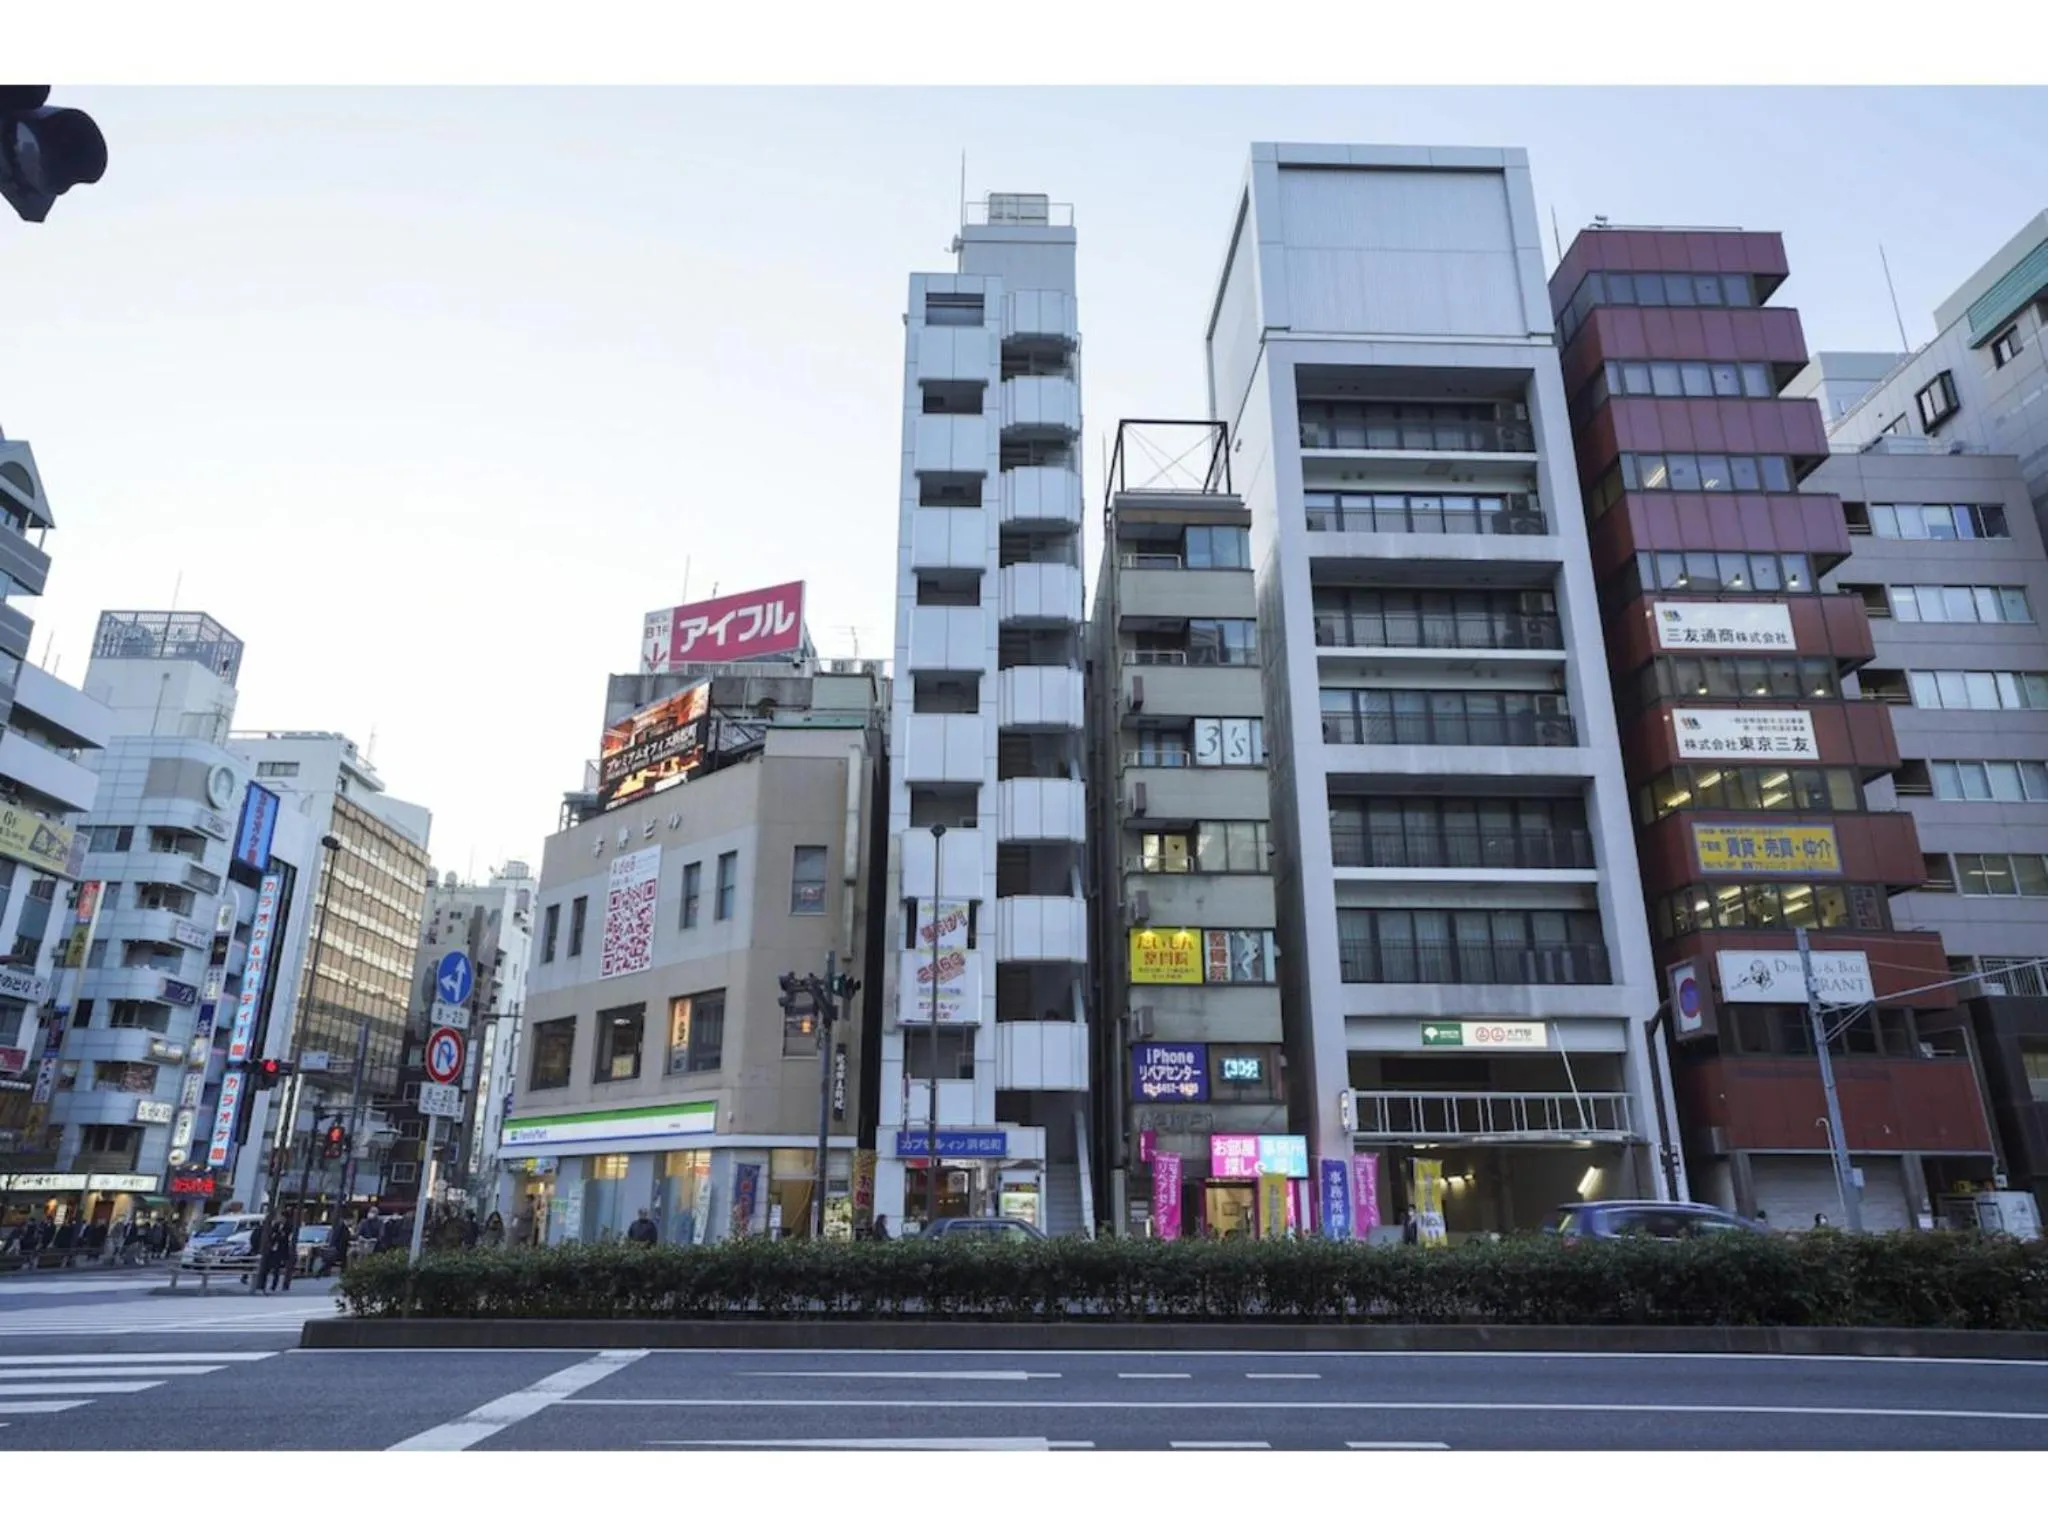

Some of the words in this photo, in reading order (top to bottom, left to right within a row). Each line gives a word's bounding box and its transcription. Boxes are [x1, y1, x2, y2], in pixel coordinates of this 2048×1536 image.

[679, 600, 795, 653] アイフル
[1667, 628, 1789, 644] 三友通商株式会社
[1196, 725, 1247, 758] 3's
[1684, 736, 1811, 753] 株式会社東京三友
[1139, 1064, 1201, 1081] リペアセンター
